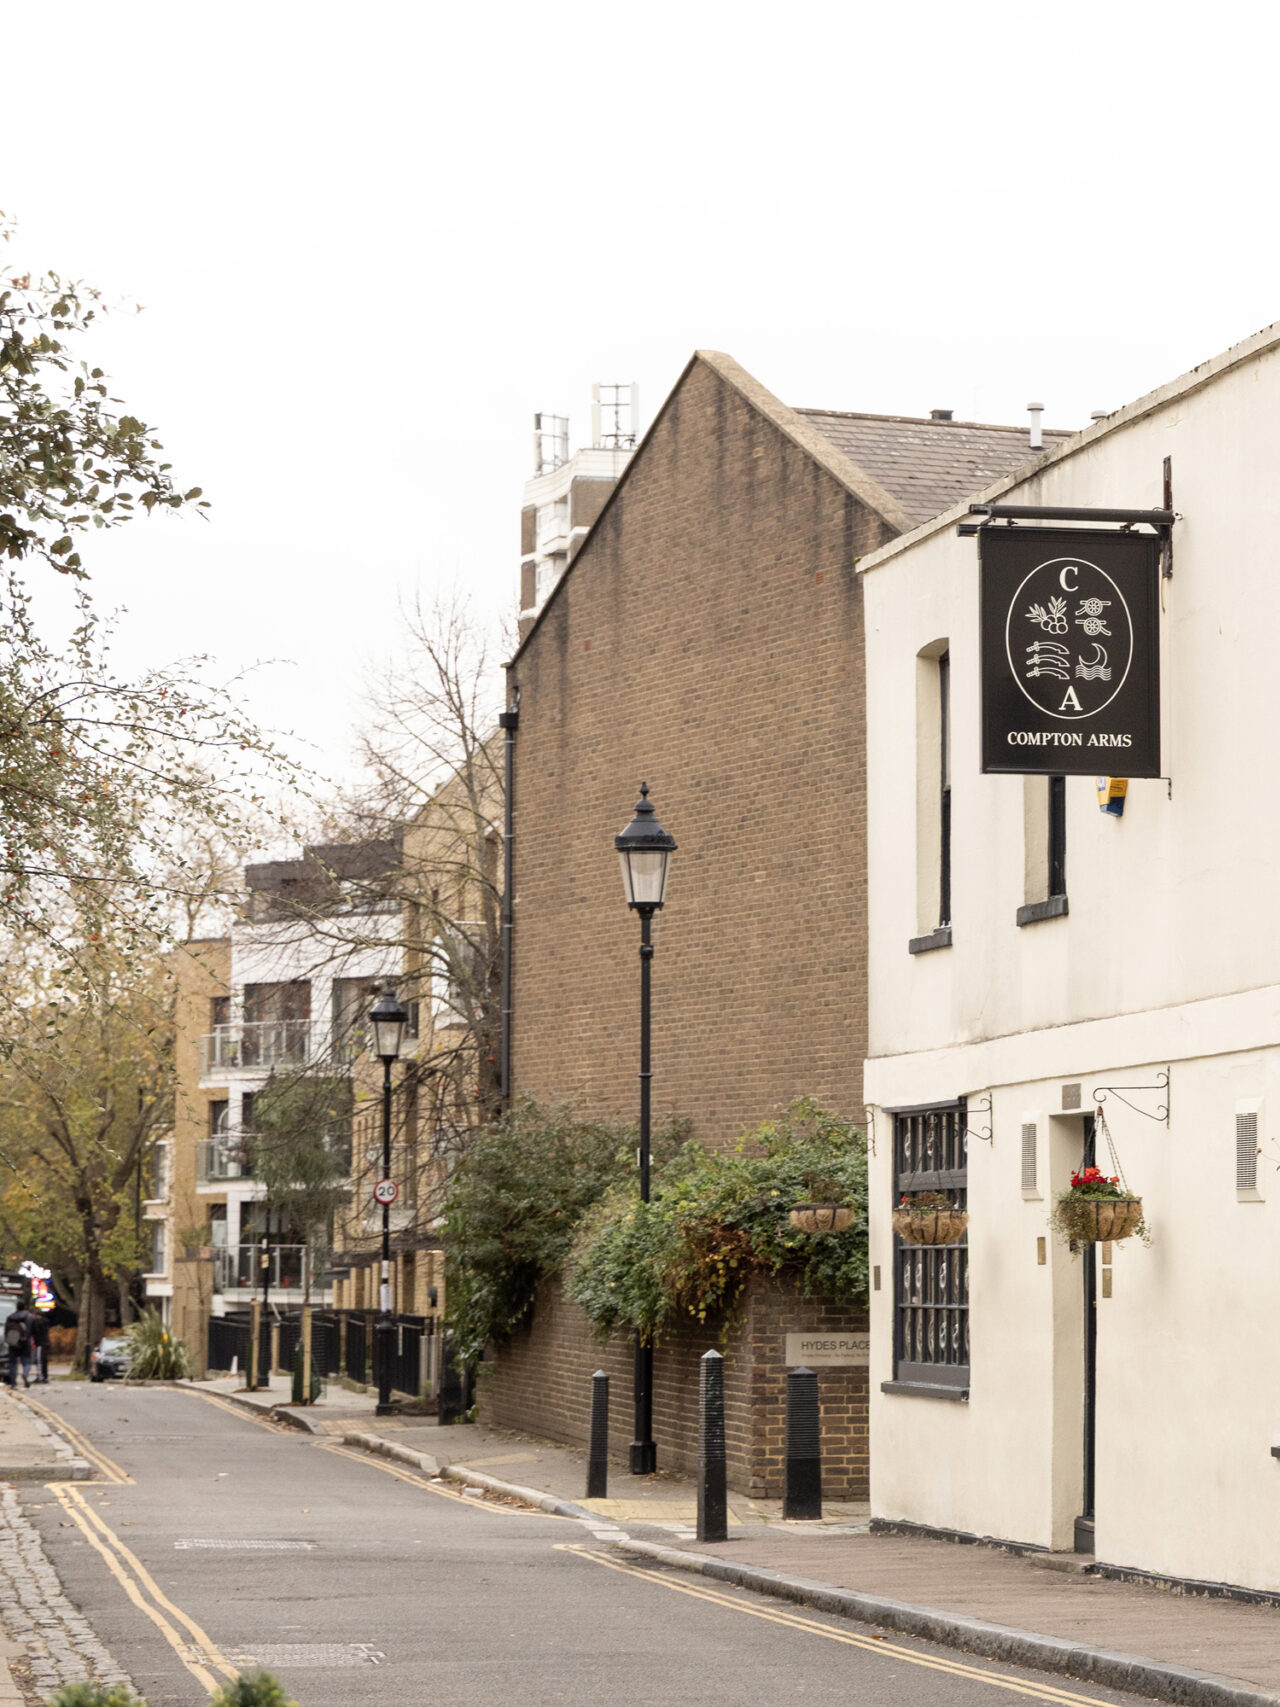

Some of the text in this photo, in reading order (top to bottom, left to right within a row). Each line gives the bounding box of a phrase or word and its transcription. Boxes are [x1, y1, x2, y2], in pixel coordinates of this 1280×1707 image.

[1058, 566, 1080, 592] C
[1058, 685, 1084, 711] A
[1006, 731, 1133, 748] COMPTON ARMS
[378, 1185, 395, 1196] 20
[801, 1340, 837, 1350] HYDES
